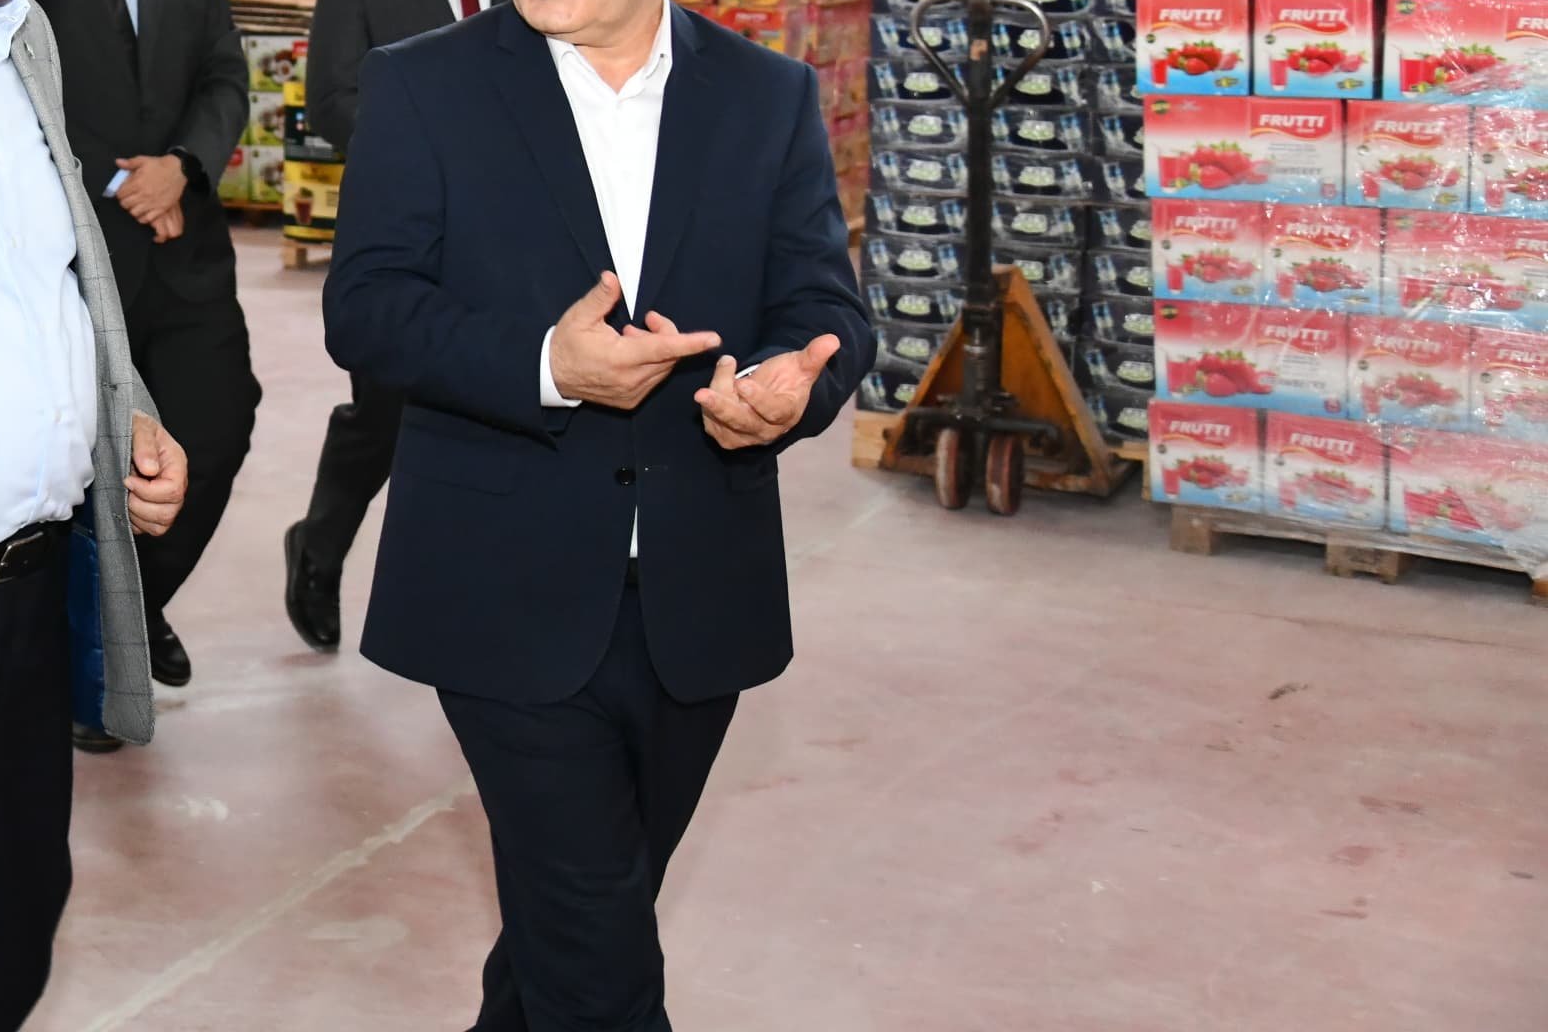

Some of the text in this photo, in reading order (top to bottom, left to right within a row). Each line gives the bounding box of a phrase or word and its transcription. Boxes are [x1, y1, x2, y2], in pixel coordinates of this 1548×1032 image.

[1158, 9, 1223, 21] FRUTTI
[1279, 9, 1347, 22] FRUTTI
[1259, 114, 1325, 127] FRUTTI
[1264, 324, 1328, 341] FRUTTI
[1170, 420, 1231, 436] FRUTTI
[1290, 432, 1355, 454] FRUTTI
